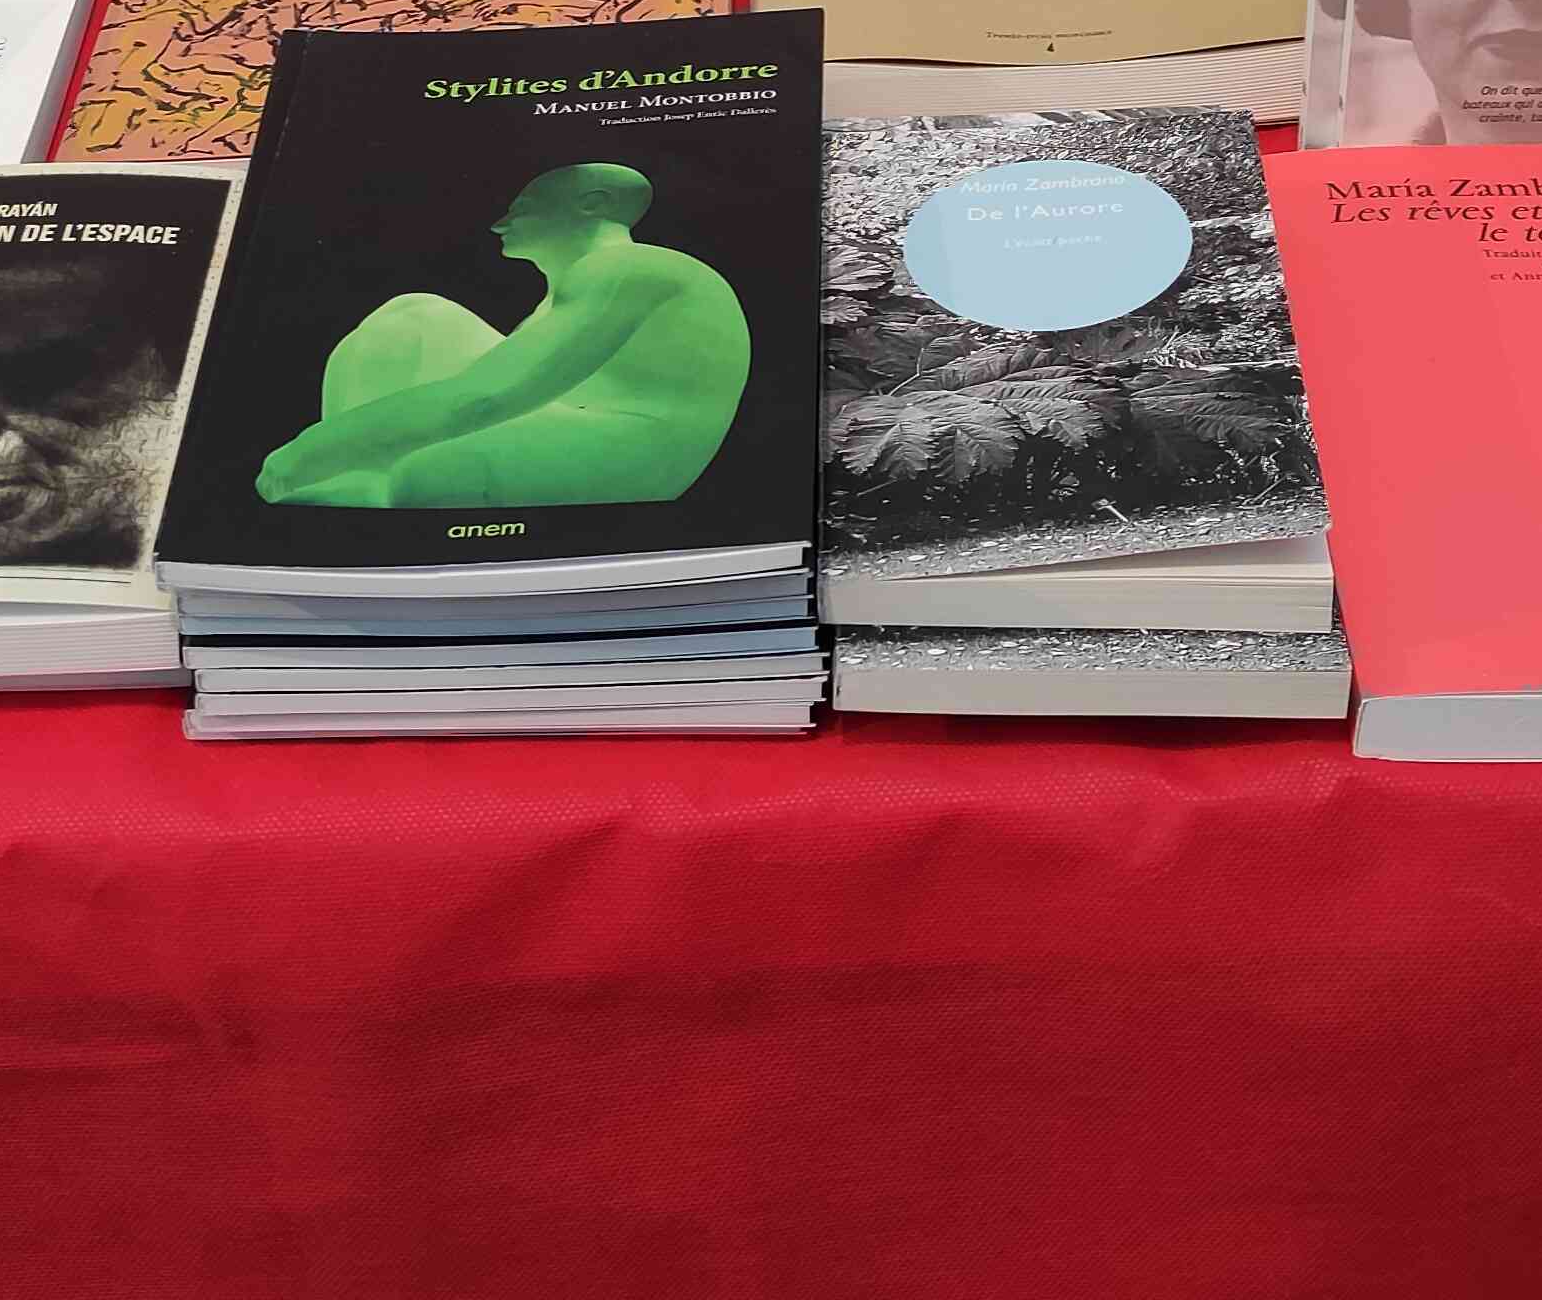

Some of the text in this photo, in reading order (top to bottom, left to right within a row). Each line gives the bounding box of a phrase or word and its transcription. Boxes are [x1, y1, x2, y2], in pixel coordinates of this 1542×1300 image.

[424, 63, 779, 103] Stylites d'Andorre
[534, 89, 777, 115] MANUEL MONTOBBIO
[1326, 178, 1435, 200] María
[968, 208, 1003, 221] De
[1331, 204, 1390, 223] Les
[1407, 201, 1495, 221] rêves
[21, 224, 57, 241] DE
[62, 224, 180, 245] L'ESPACE
[1478, 223, 1508, 242] le
[448, 522, 525, 538] anem
